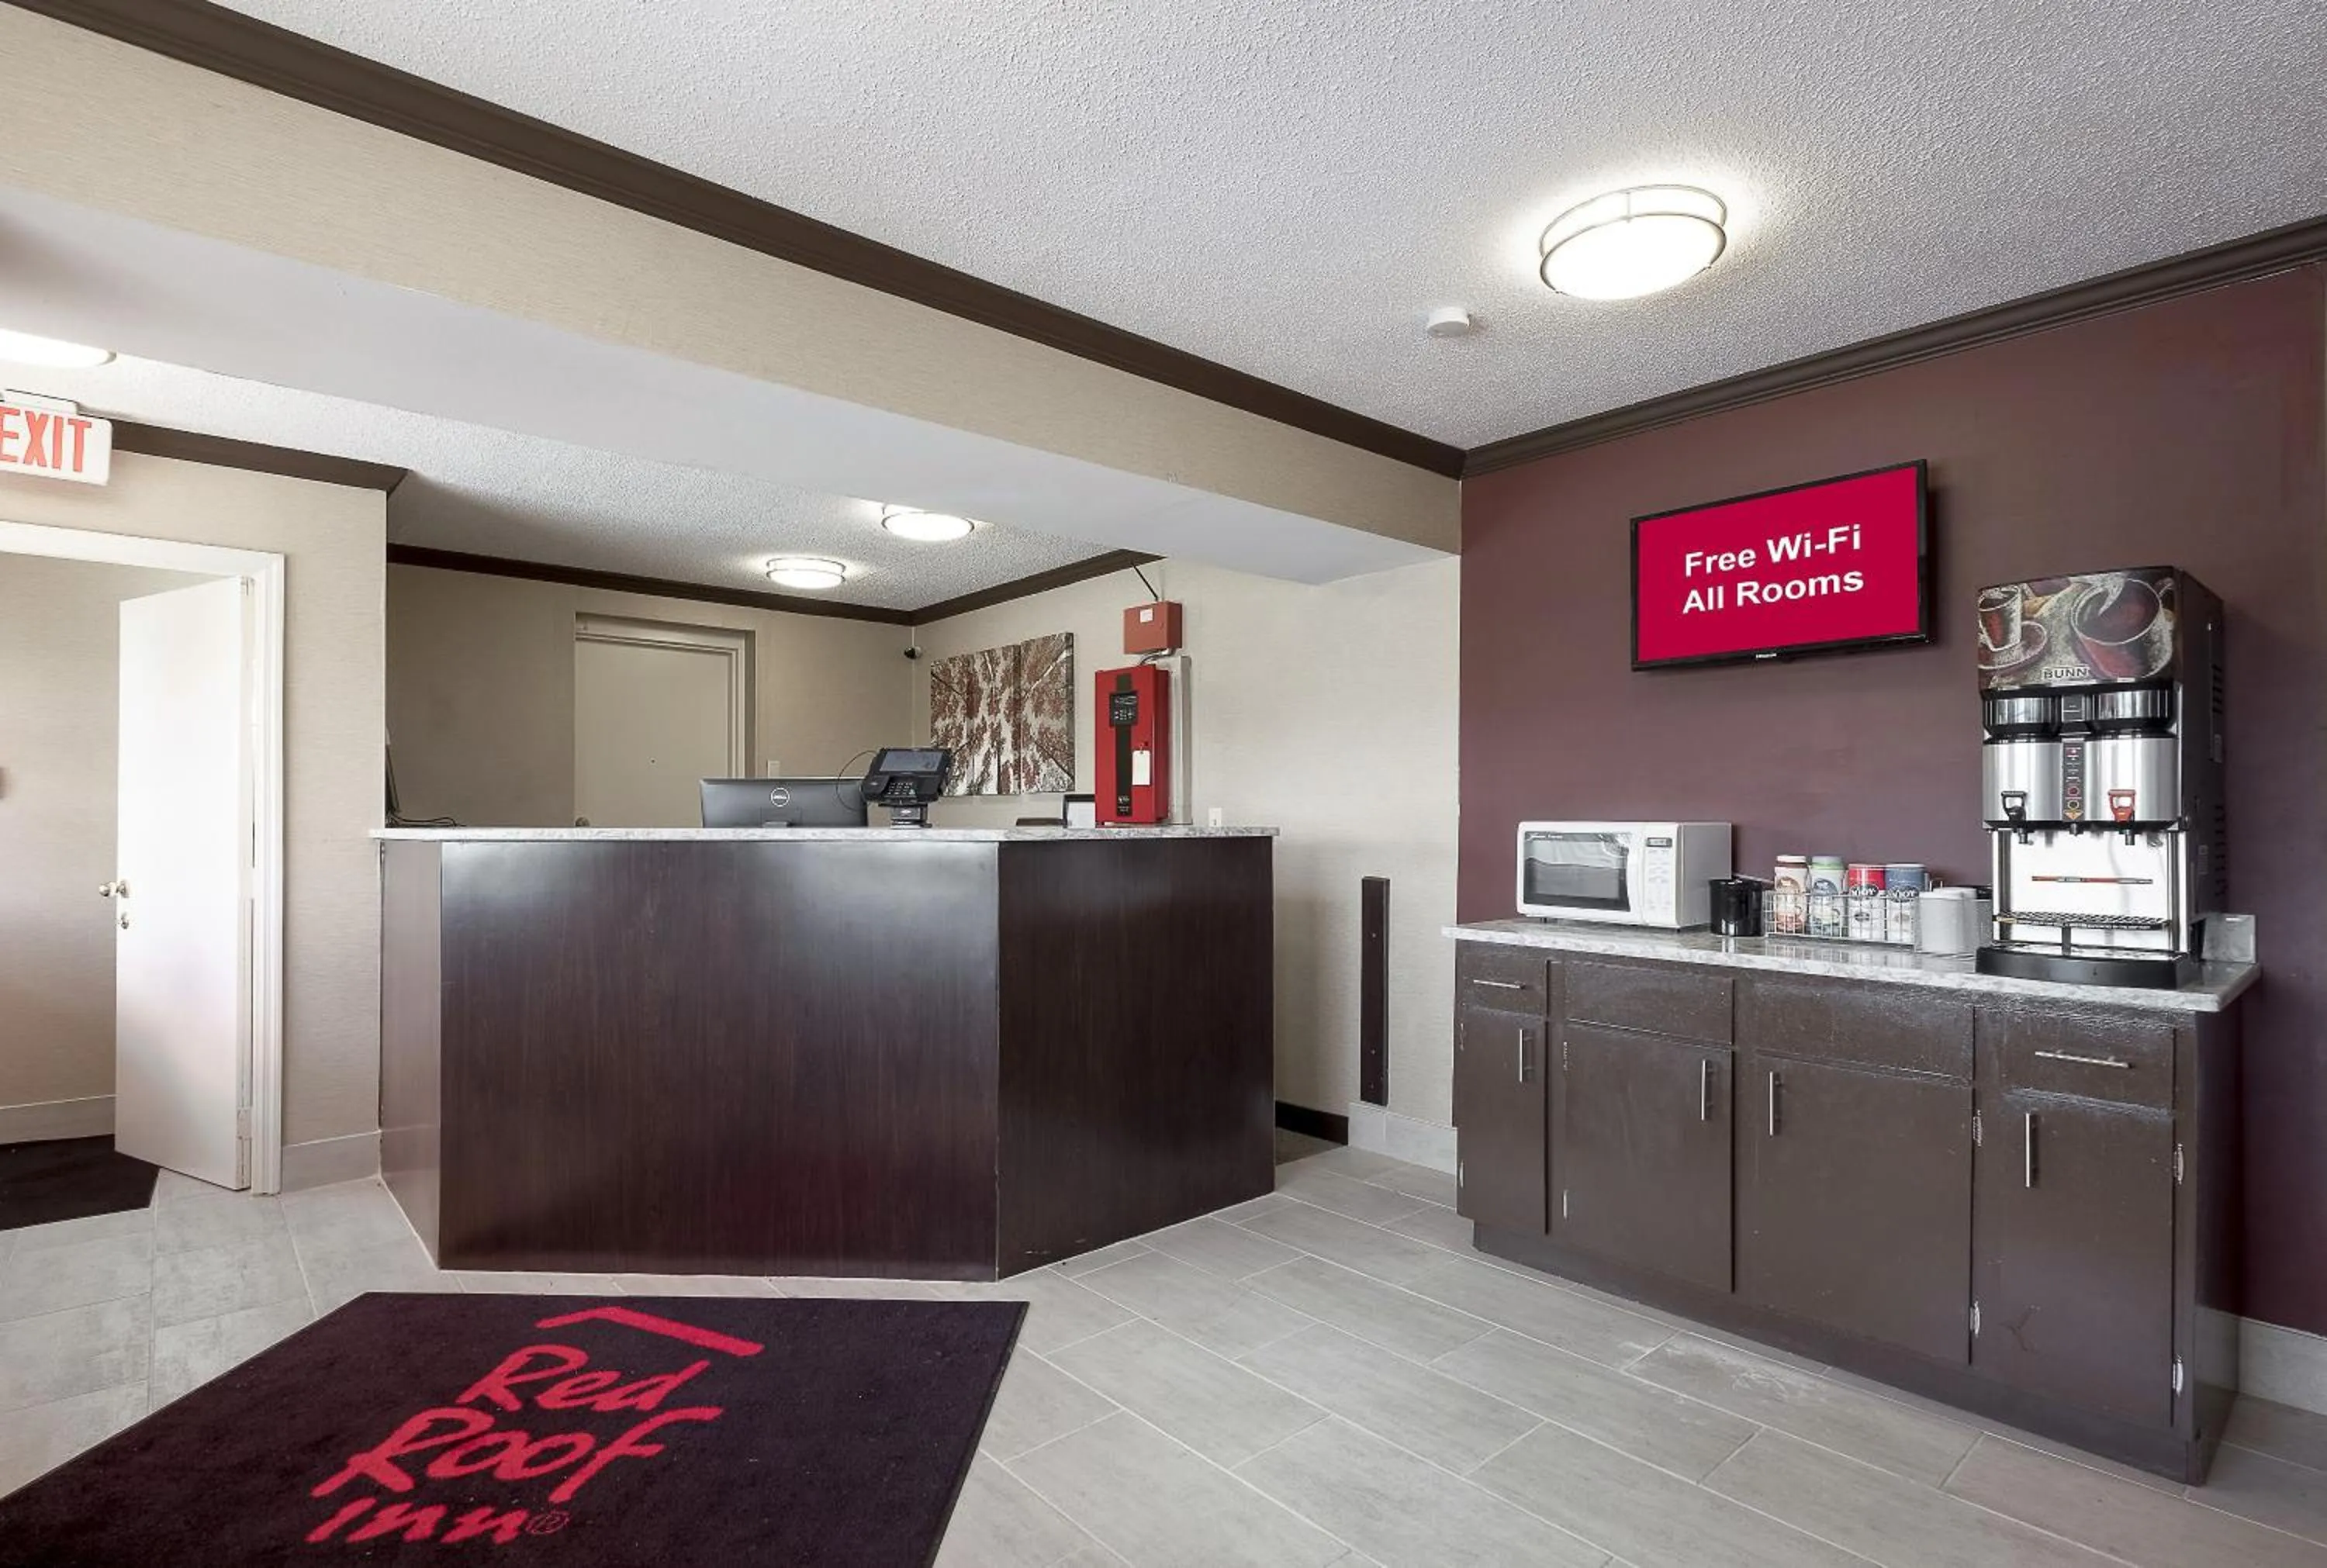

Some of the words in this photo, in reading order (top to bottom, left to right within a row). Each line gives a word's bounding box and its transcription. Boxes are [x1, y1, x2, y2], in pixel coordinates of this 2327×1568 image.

[0, 406, 92, 472] EXIT
[1685, 548, 1757, 577] Free
[1766, 524, 1862, 563] Wi-Fi
[1682, 586, 1724, 614] All
[1736, 571, 1865, 607] Rooms
[2044, 668, 2087, 679] BUNN
[455, 1343, 711, 1412] Red
[310, 1406, 725, 1504] Roof
